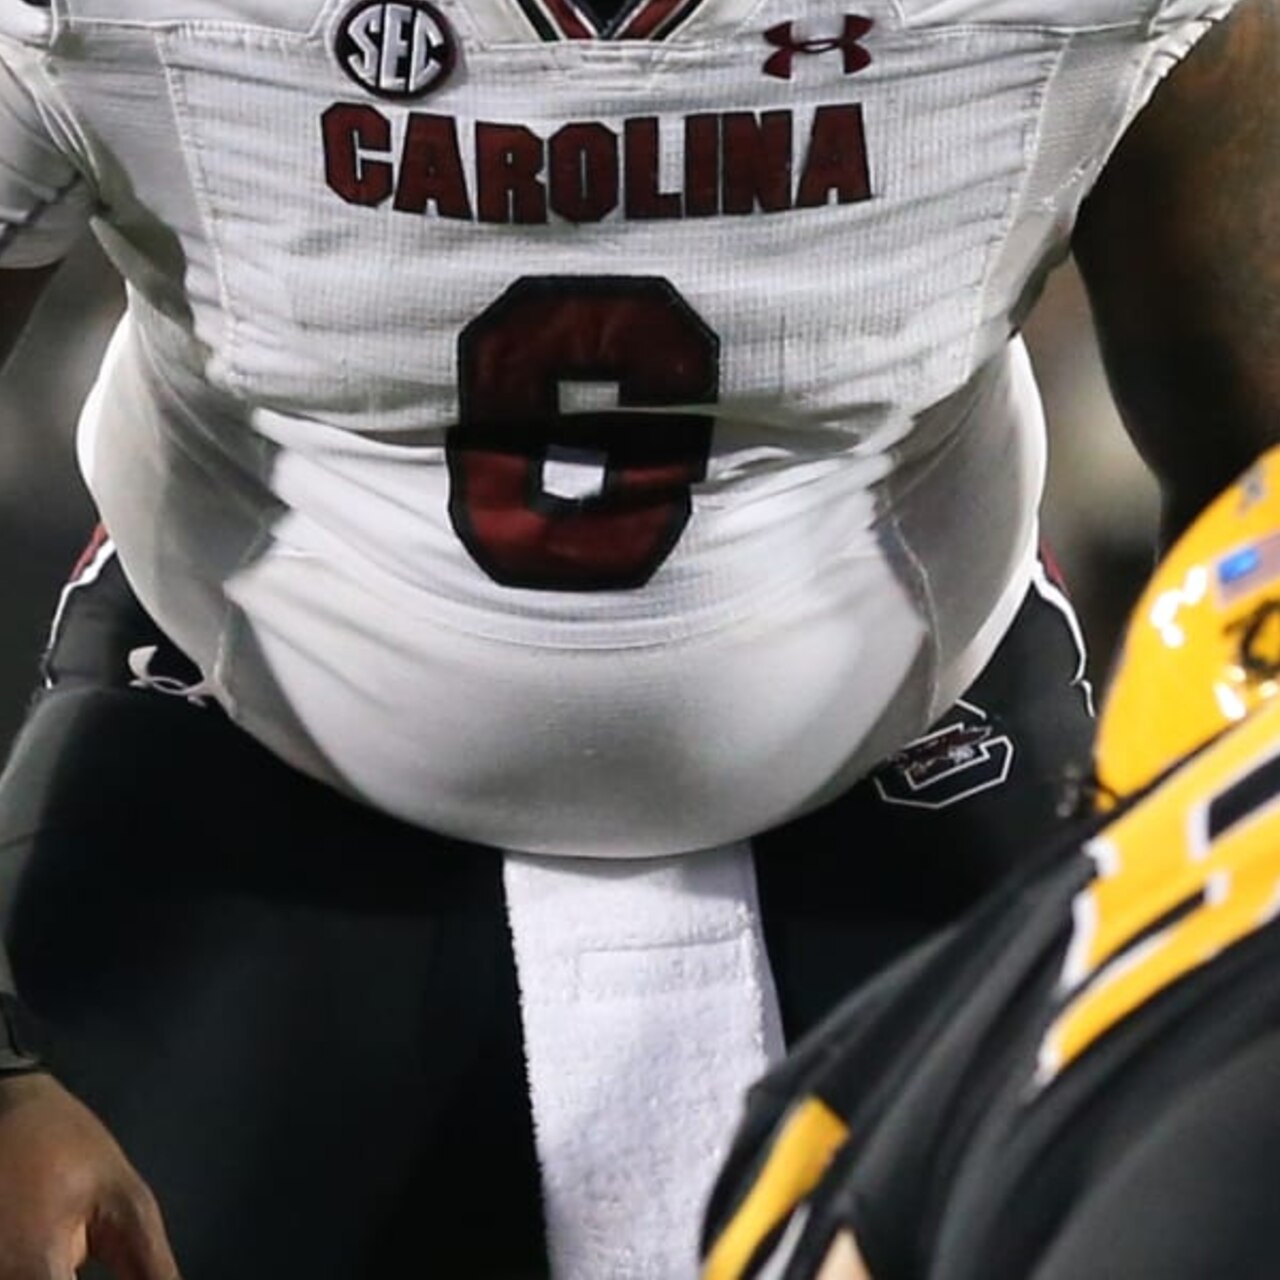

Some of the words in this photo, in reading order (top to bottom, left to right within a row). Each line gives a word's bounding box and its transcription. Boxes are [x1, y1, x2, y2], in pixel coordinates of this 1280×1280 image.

[346, 0, 444, 91] SEC
[319, 101, 873, 223] CAROLINA
[445, 274, 721, 591] 6
